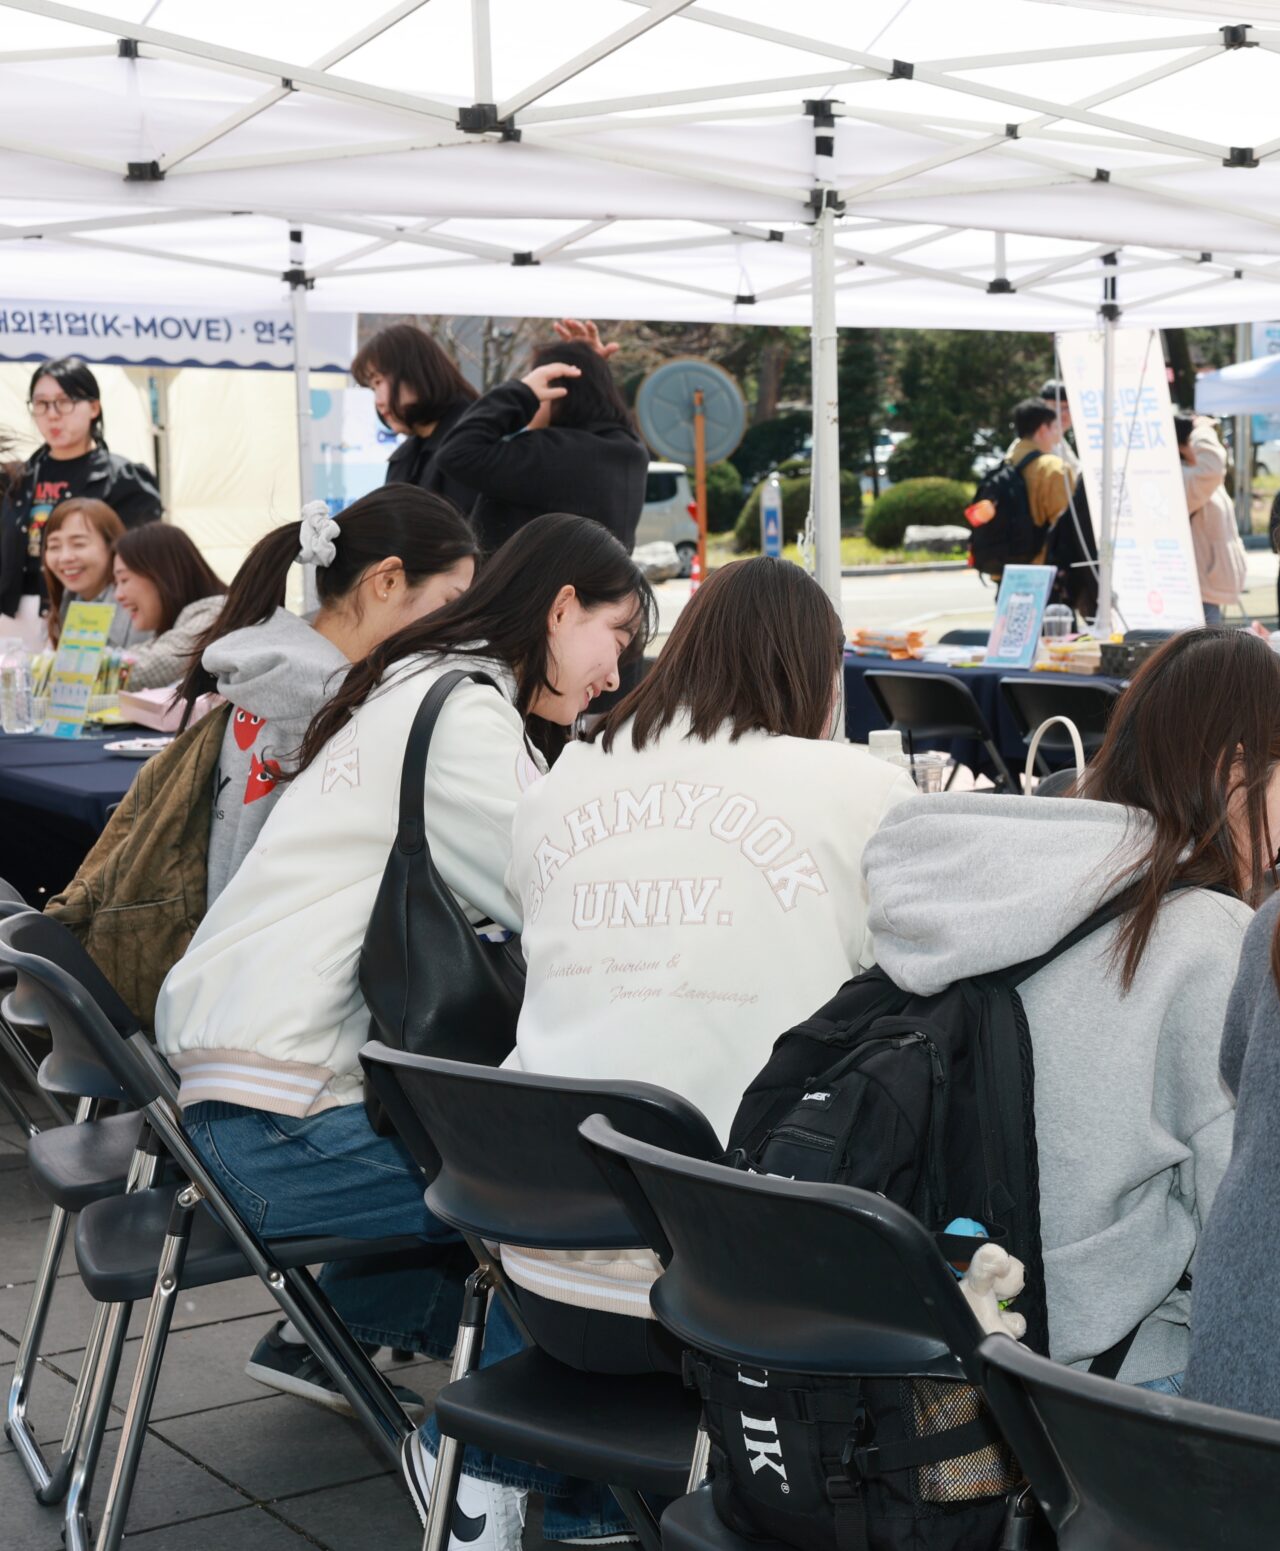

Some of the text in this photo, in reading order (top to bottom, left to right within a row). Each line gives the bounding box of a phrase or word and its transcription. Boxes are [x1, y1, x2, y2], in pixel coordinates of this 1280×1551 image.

[254, 320, 295, 344] 연수
[572, 878, 734, 931] UNIV.
[601, 956, 660, 974] Tourism
[666, 953, 681, 969] &
[610, 981, 759, 1008] Foreign Language
